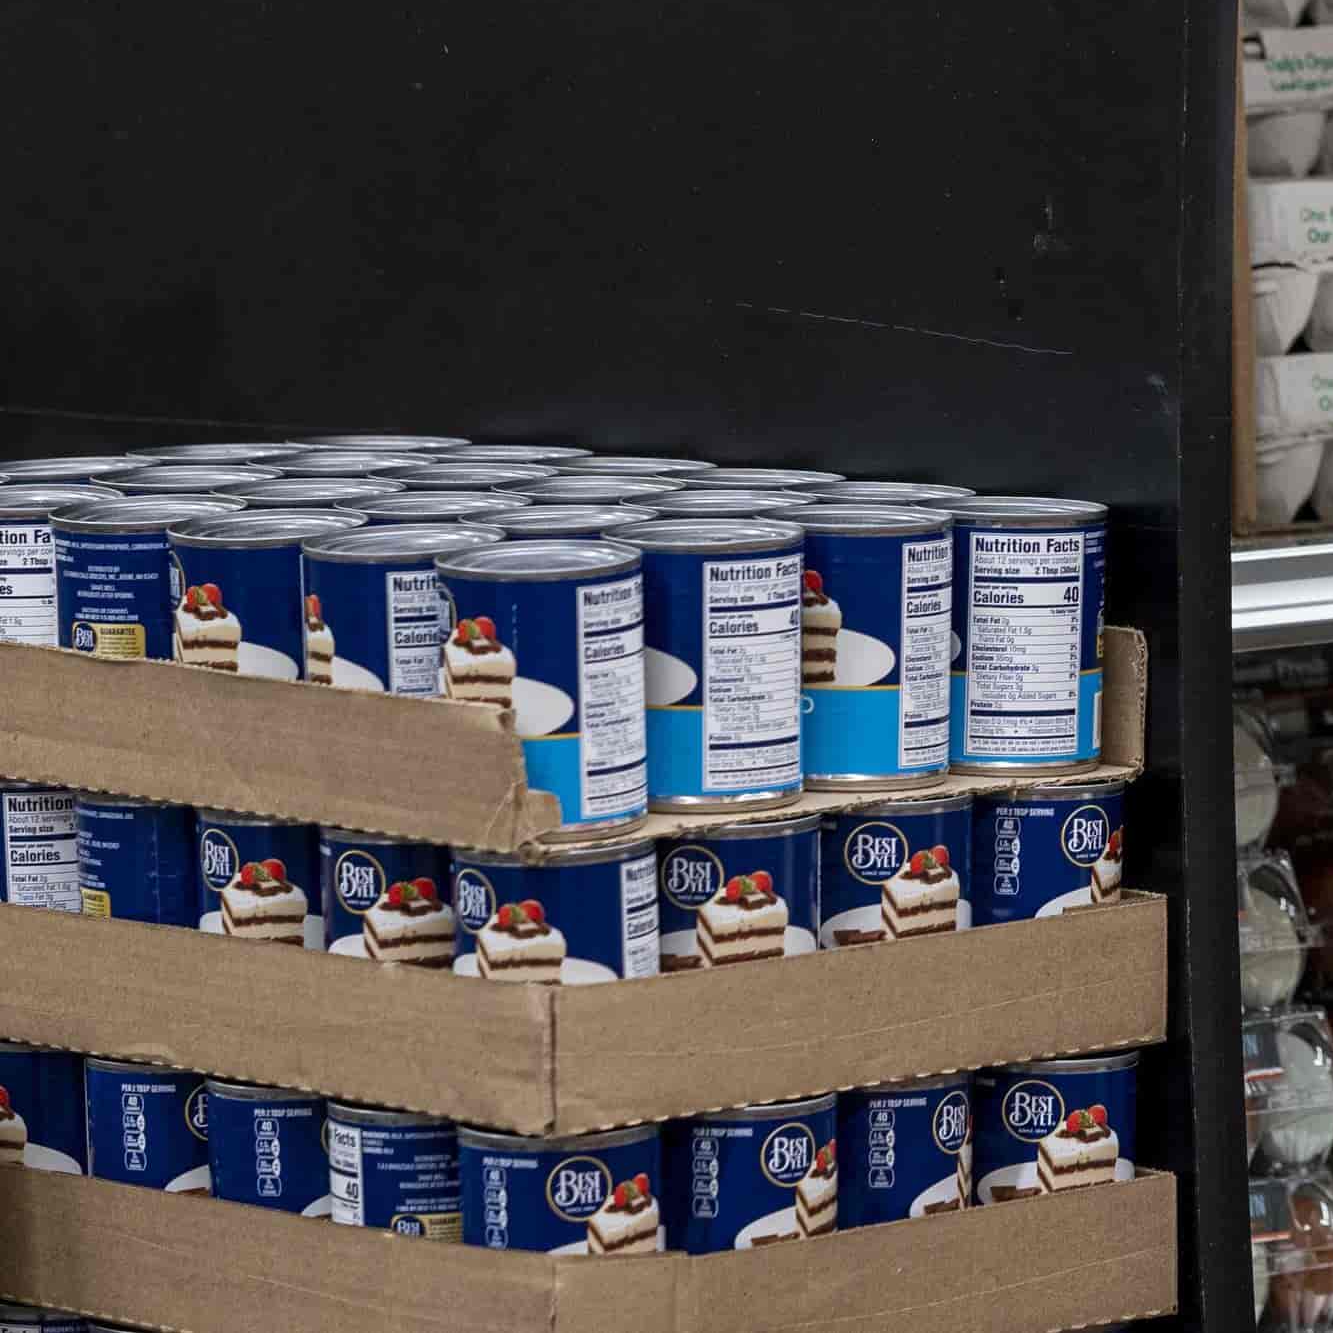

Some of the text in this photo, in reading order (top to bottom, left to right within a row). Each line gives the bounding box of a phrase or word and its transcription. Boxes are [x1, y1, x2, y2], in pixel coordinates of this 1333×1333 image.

[974, 537, 1081, 554] Nutrition Facts
[709, 565, 771, 582] Nutrition
[974, 566, 1002, 576] Serving
[393, 575, 437, 592] Nutrit
[973, 587, 1080, 605] Calories 40
[906, 600, 944, 614] Calories
[709, 621, 759, 635] Calories
[8, 796, 73, 813] Nutrition
[1068, 819, 1103, 852] BEST
[10, 849, 61, 863] Calories
[852, 834, 898, 869] BEST
[340, 861, 375, 897] BEST
[668, 858, 712, 893] BEST
[1009, 1091, 1055, 1127] BEST
[769, 1137, 808, 1172] BEST
[555, 1170, 601, 1207] BEST
